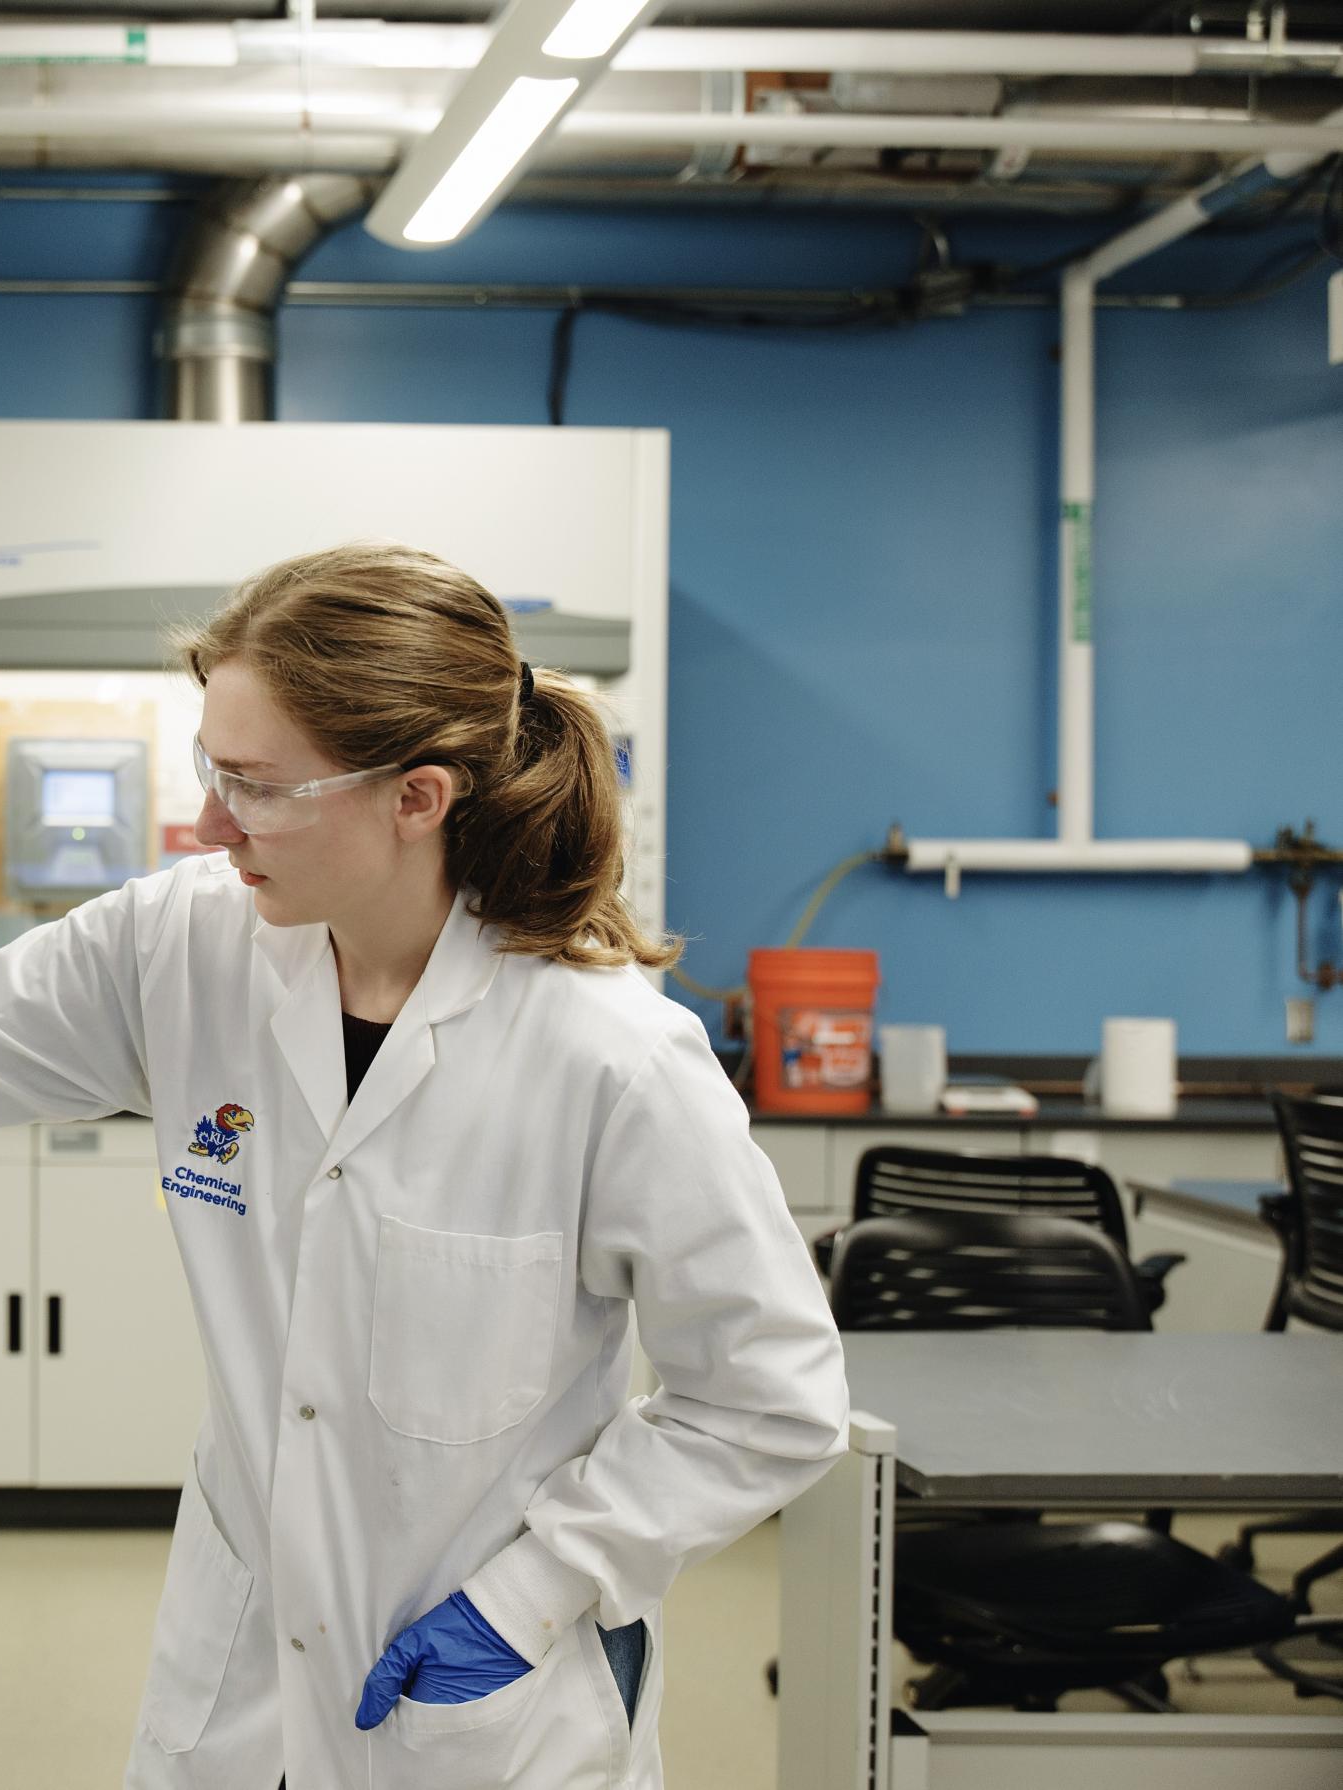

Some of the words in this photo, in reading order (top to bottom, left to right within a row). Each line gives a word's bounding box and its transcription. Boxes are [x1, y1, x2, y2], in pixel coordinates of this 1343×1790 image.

[209, 1131, 226, 1145] KU
[162, 1176, 247, 1216] Engineering
[174, 1166, 242, 1196] Chemical
